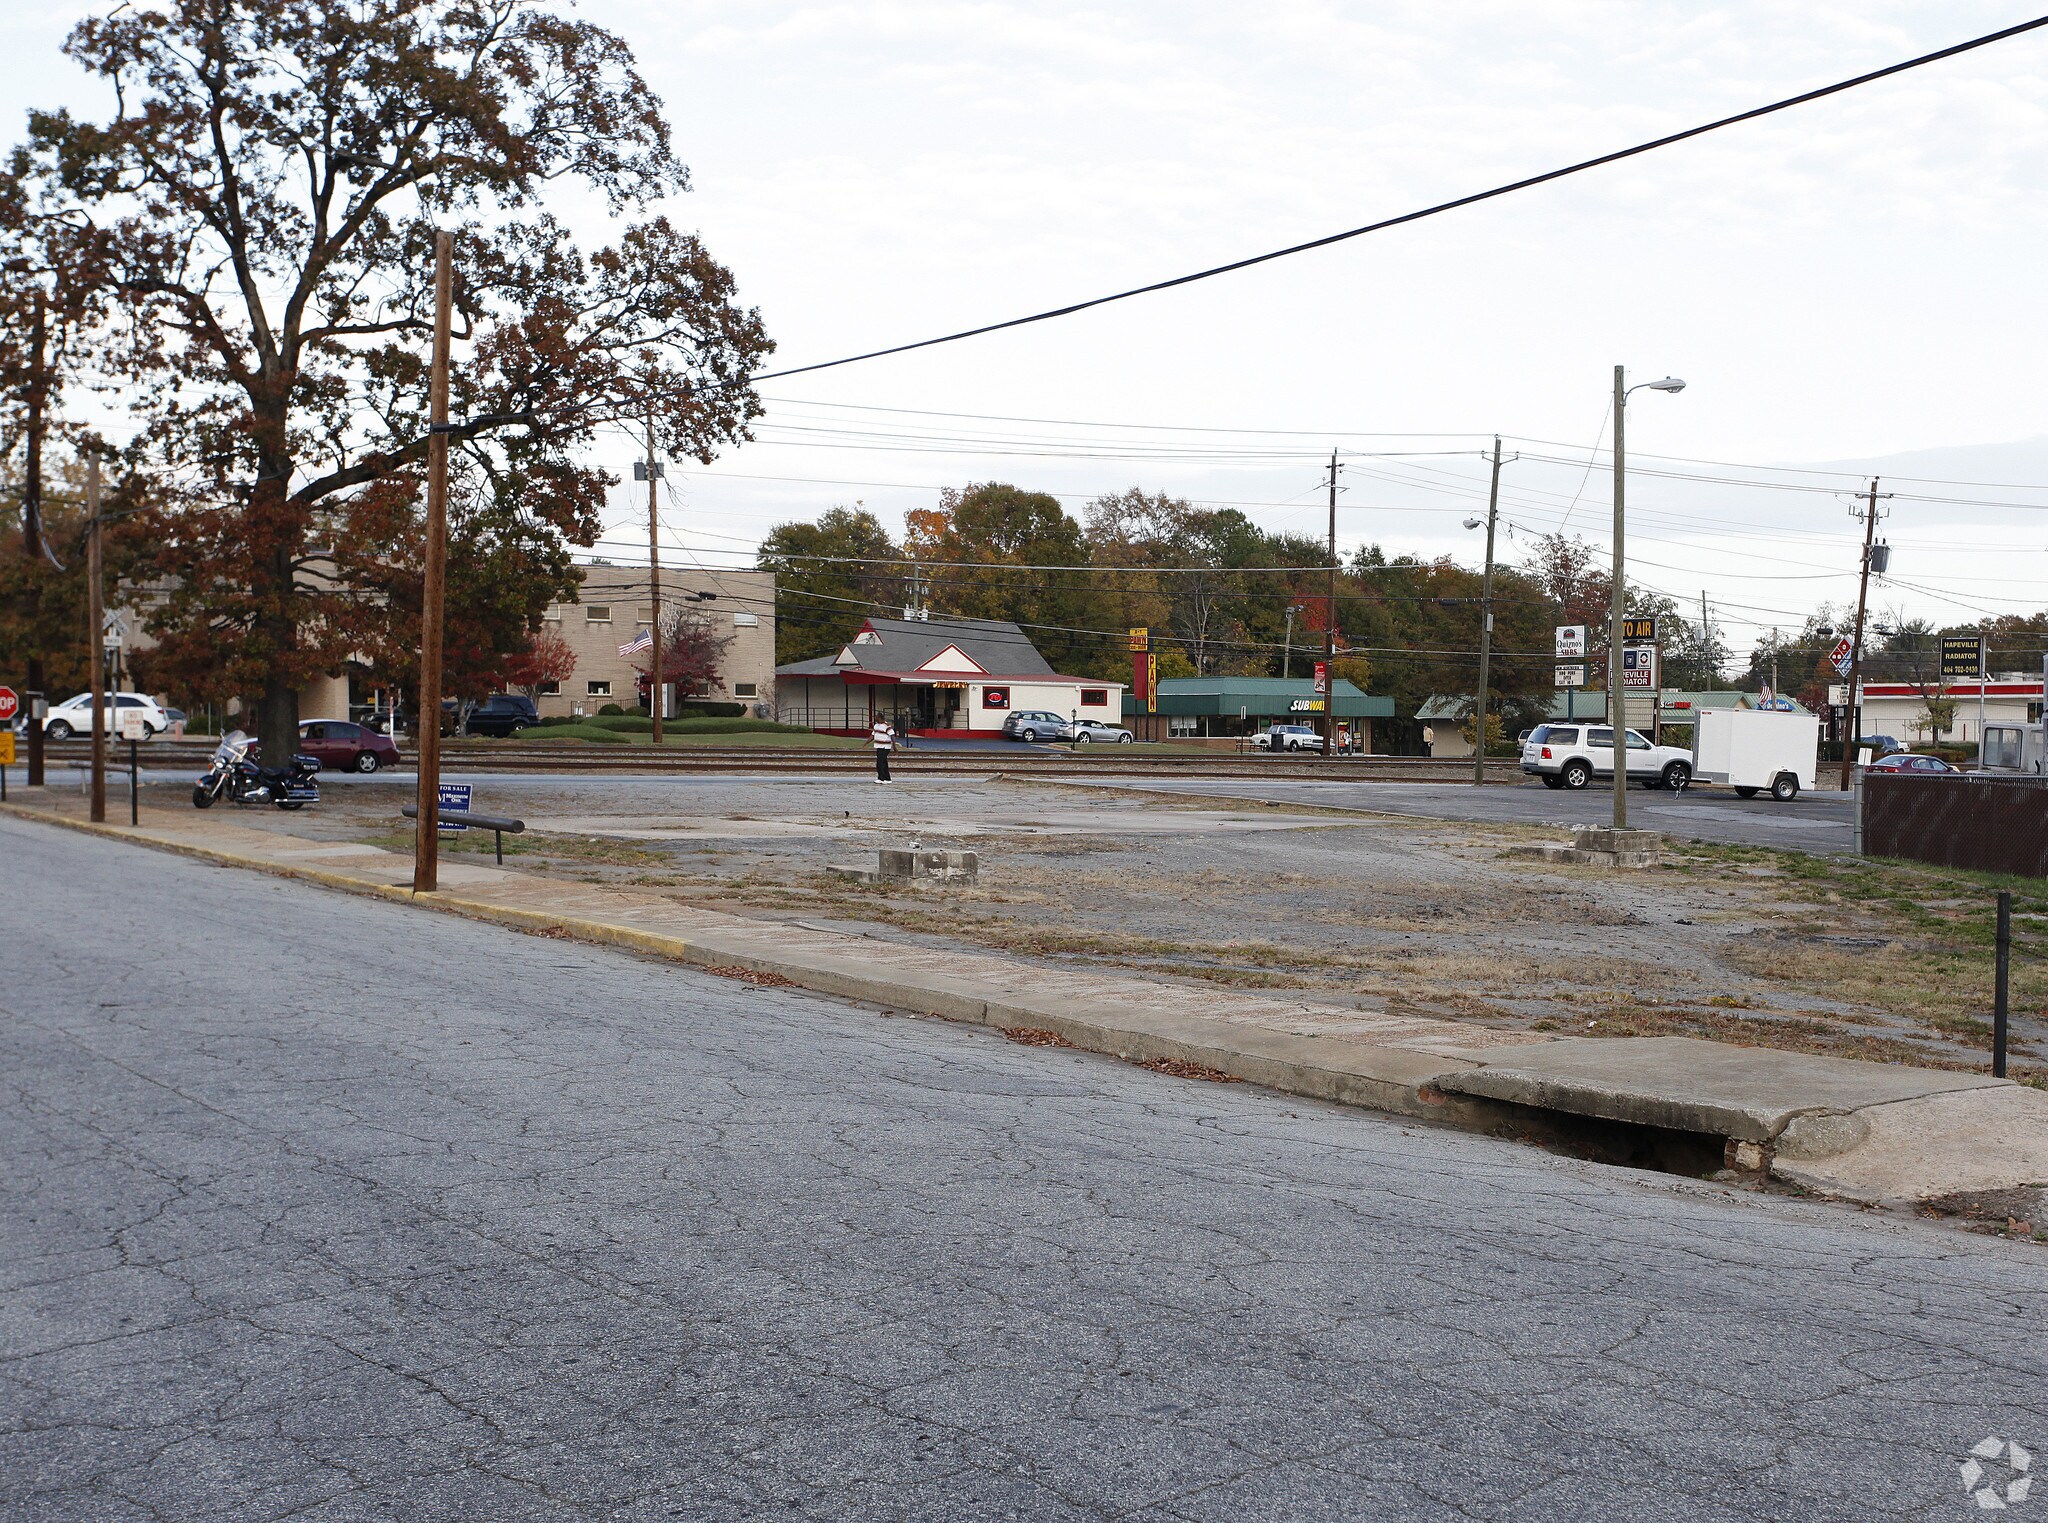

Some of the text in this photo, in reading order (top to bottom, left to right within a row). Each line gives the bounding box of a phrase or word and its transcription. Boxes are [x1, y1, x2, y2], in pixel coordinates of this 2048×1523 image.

[1636, 621, 1651, 636] AIR
[1556, 640, 1582, 650] Quizno's
[0, 696, 15, 710] OP
[1290, 700, 1325, 711] SUBWA
